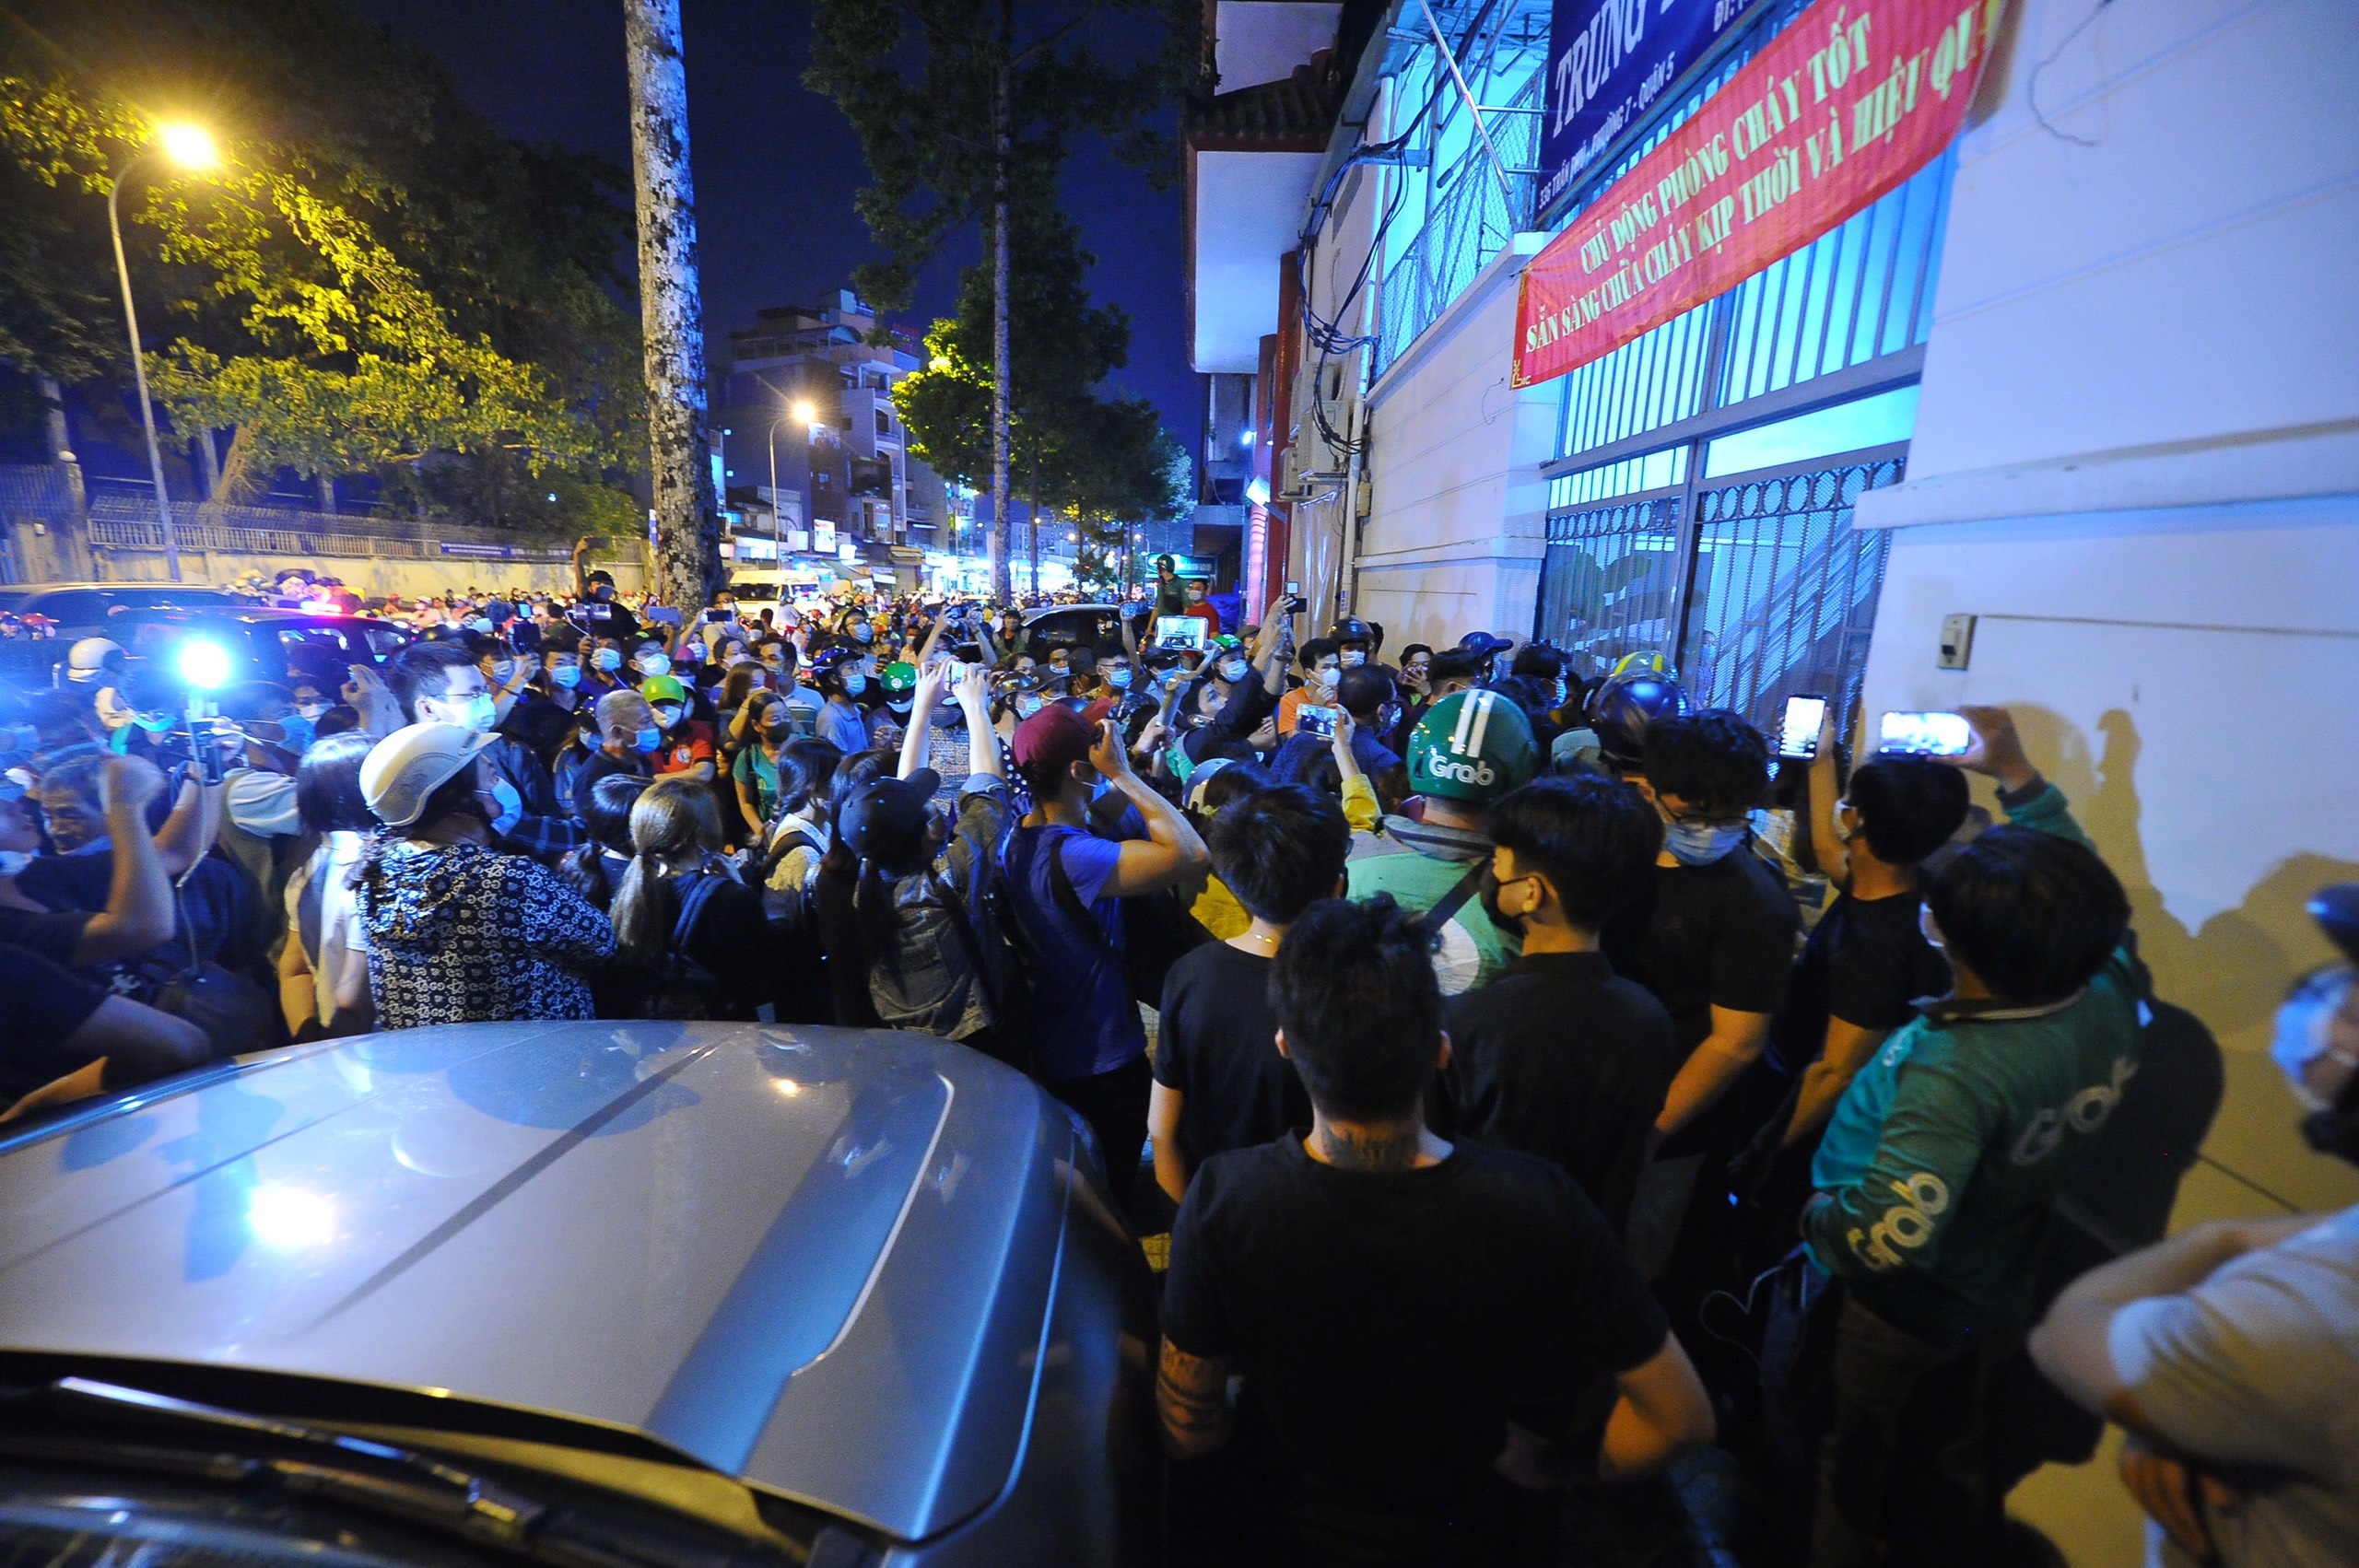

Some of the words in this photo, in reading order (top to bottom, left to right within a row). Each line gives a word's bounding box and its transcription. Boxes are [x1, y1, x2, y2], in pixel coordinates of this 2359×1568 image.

[1554, 0, 1648, 138] TRUNG
[1625, 96, 1633, 123] 7
[1638, 63, 1665, 111] QUẬN
[1665, 51, 1675, 81] 5
[1561, 290, 1601, 337] SÀNG
[1601, 258, 1645, 312] CHỮA
[1644, 223, 1694, 285] CHÁY
[1695, 194, 1736, 254] KỊP
[1739, 146, 1802, 225] THỜI
[1805, 105, 1844, 180] VÀ
[1850, 47, 1931, 155] HIỆU
[1580, 219, 1611, 275] CHỦ
[1610, 191, 1659, 252] ĐỘNG
[1657, 132, 1730, 217] PHÒNG
[1732, 69, 1802, 161] CHÁY
[1807, 5, 1872, 105] TỐT
[1429, 755, 1495, 786] Grab
[1847, 1172, 1949, 1272] Grab
